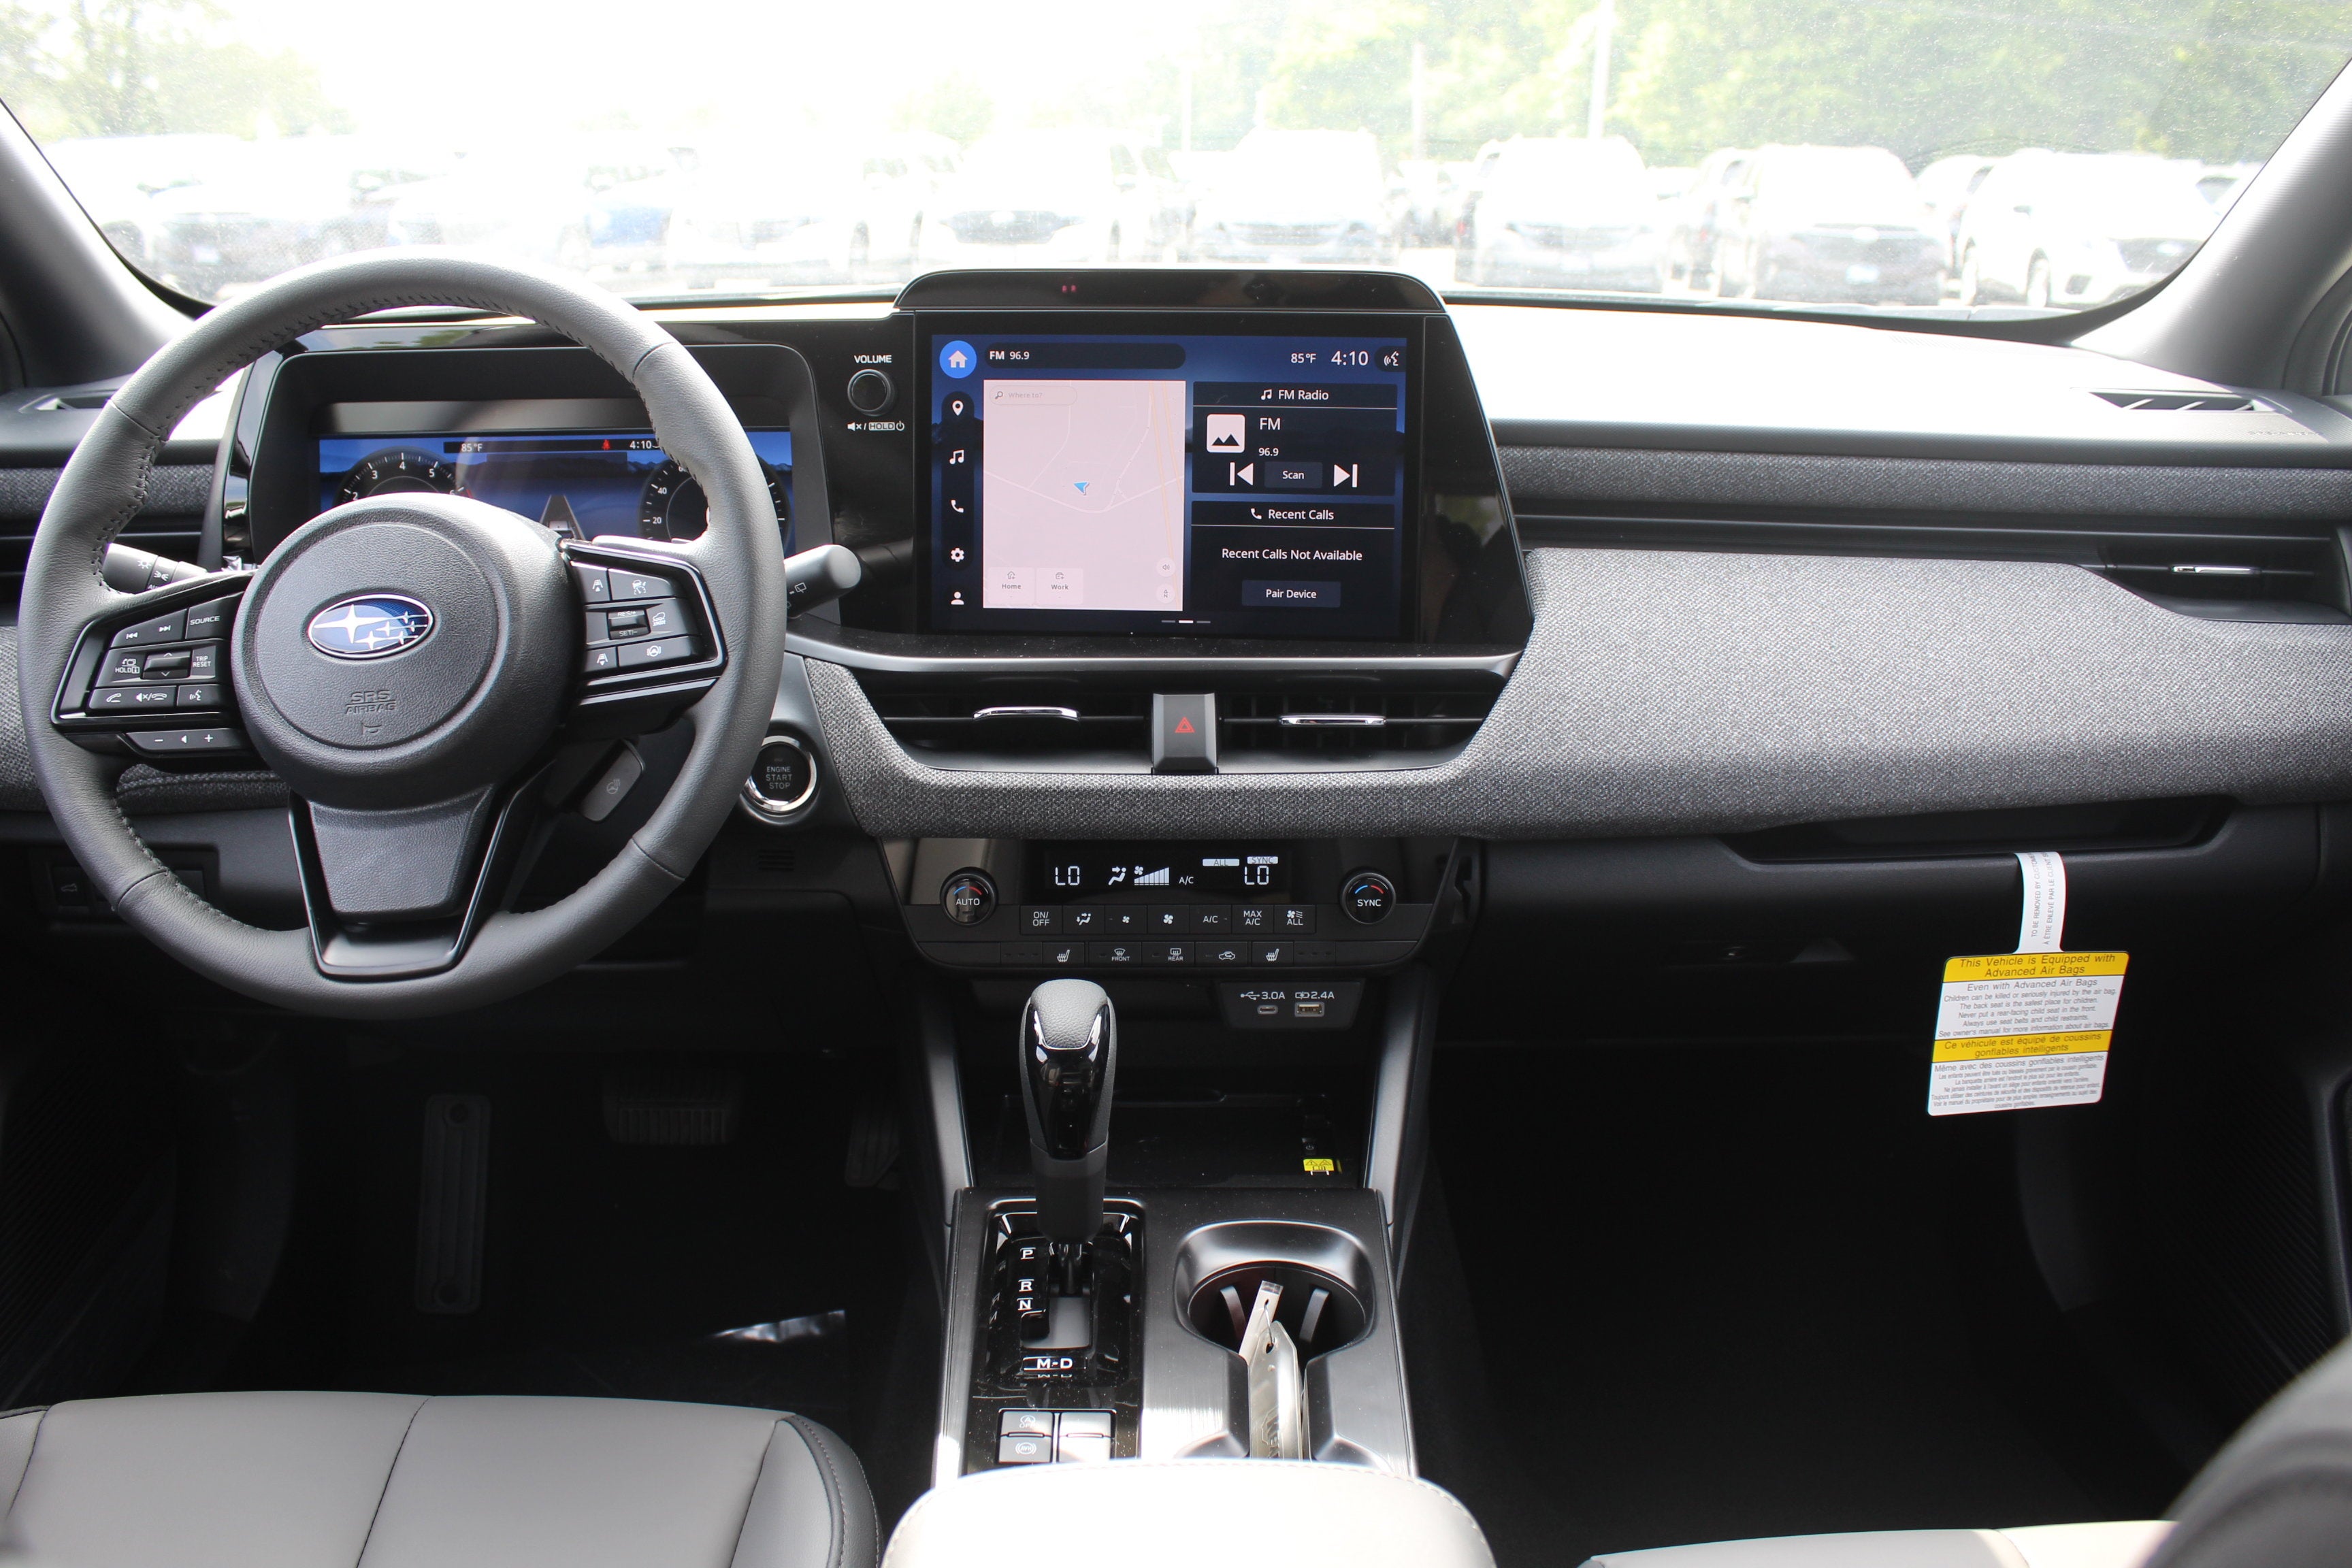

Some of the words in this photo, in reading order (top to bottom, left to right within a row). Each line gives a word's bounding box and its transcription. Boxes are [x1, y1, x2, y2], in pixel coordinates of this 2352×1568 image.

[853, 355, 892, 363] VOLUME
[989, 350, 1005, 360] FM
[1009, 351, 1030, 360] 96.9
[1330, 350, 1369, 366] 4:10
[1278, 389, 1294, 399] FM
[1298, 389, 1329, 400] Radio
[1259, 417, 1281, 430] FM
[630, 440, 651, 449] 4:10
[1258, 447, 1279, 457] 96.9
[399, 461, 406, 470] 4
[372, 470, 378, 479] 3
[429, 468, 435, 477] 5
[1282, 470, 1305, 479] Scan
[353, 492, 358, 500] 2
[1268, 509, 1306, 519] Recent
[1309, 509, 1335, 520] Calls
[1222, 549, 1259, 559] Recent
[1262, 549, 1288, 559] Calls
[1290, 550, 1311, 560] Not
[1313, 550, 1362, 561] Available
[1265, 589, 1284, 598] Pair
[1286, 589, 1317, 598] Device
[190, 615, 220, 625] SOURCE
[350, 689, 391, 703] SRS
[345, 702, 396, 715] AIRBAG
[1252, 856, 1274, 864] SYNC
[1055, 866, 1080, 885] LO
[1244, 865, 1269, 885] LO
[1179, 876, 1194, 885] A/C
[956, 898, 980, 906] AUTO
[1203, 915, 1218, 924] A/C
[2031, 930, 2038, 938] TO
[1960, 959, 1980, 967] This
[1987, 958, 2023, 966] Vehicle
[2028, 957, 2036, 965] is
[2041, 956, 2089, 966] Equipped
[2095, 954, 2115, 962] with
[1985, 967, 2035, 977] Advanced
[2040, 966, 2053, 975] Air
[2059, 965, 2085, 976] Bags
[1967, 983, 1989, 991] Even
[2014, 980, 2056, 989] Advanced
[2076, 978, 2097, 988] Bags
[1261, 992, 1286, 1000] 3.0A
[1310, 991, 1335, 1000] 2.4A
[1022, 1249, 1033, 1259] P
[1021, 1281, 1033, 1291] R
[1019, 1299, 1032, 1310] N
